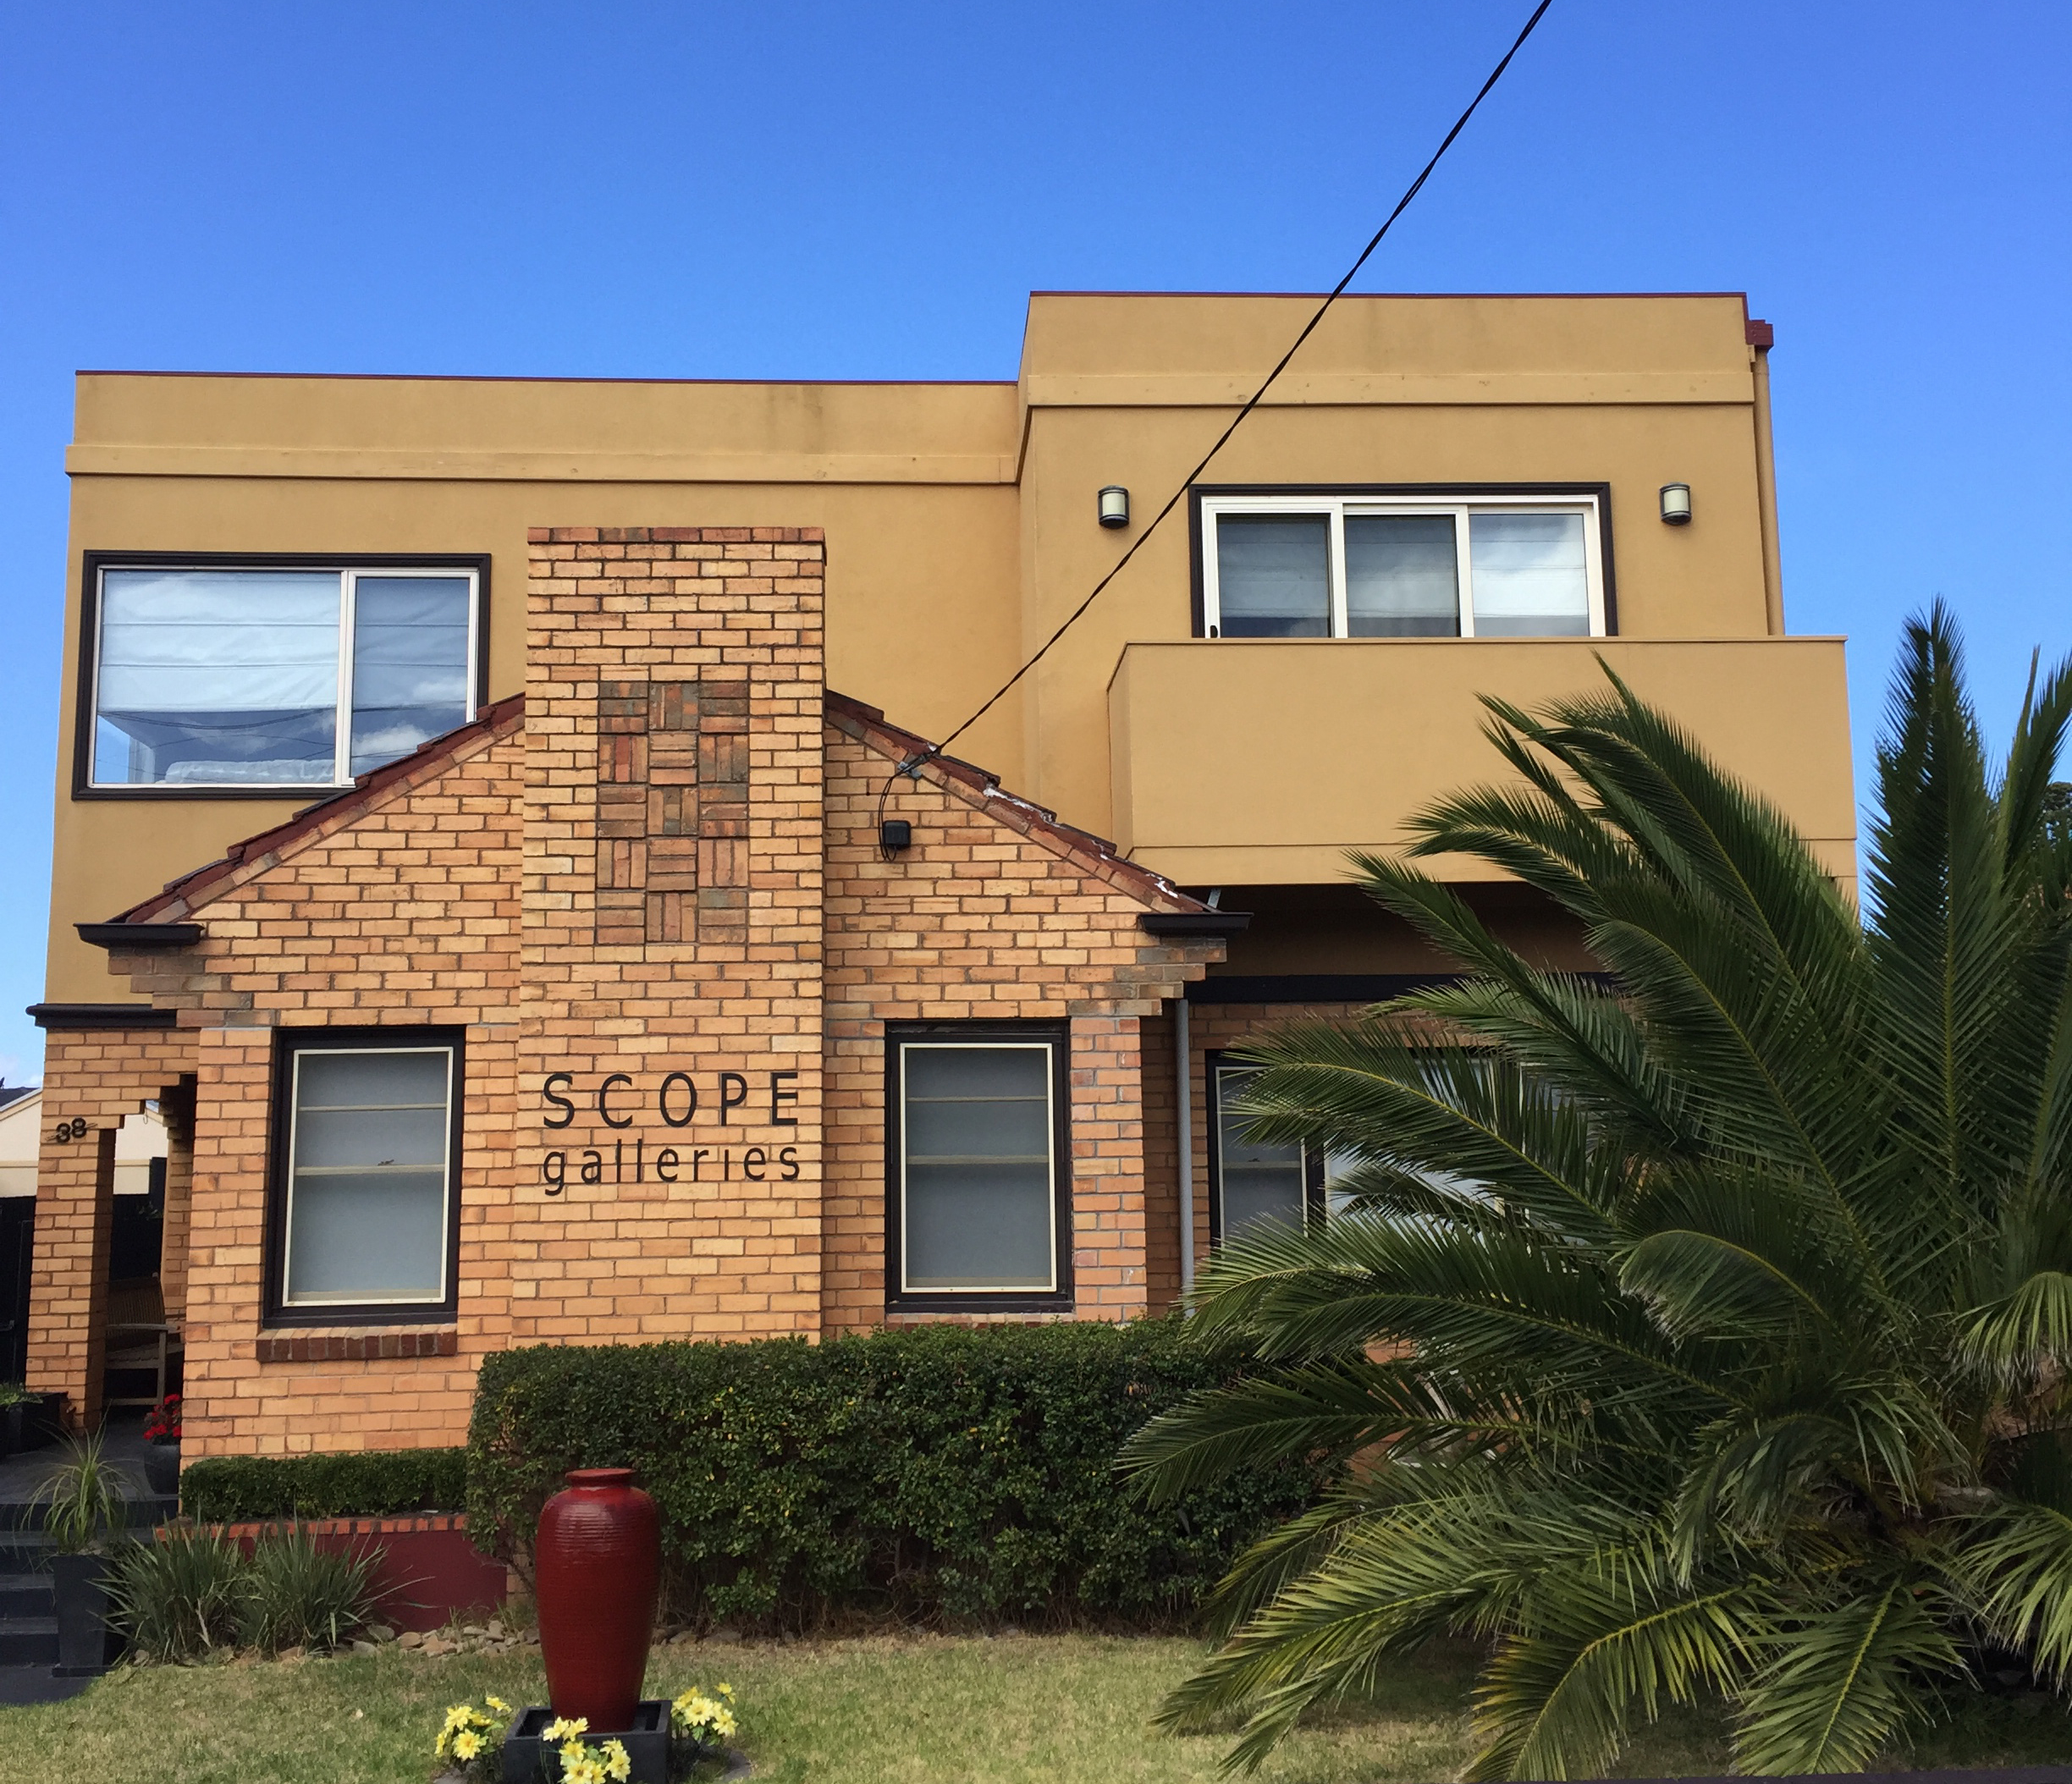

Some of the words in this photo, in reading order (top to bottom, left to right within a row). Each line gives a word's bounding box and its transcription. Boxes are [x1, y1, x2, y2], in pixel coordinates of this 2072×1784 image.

[543, 1071, 799, 1129] SCOPE
[55, 1117, 88, 1144] 38
[543, 1137, 801, 1197] galleries
